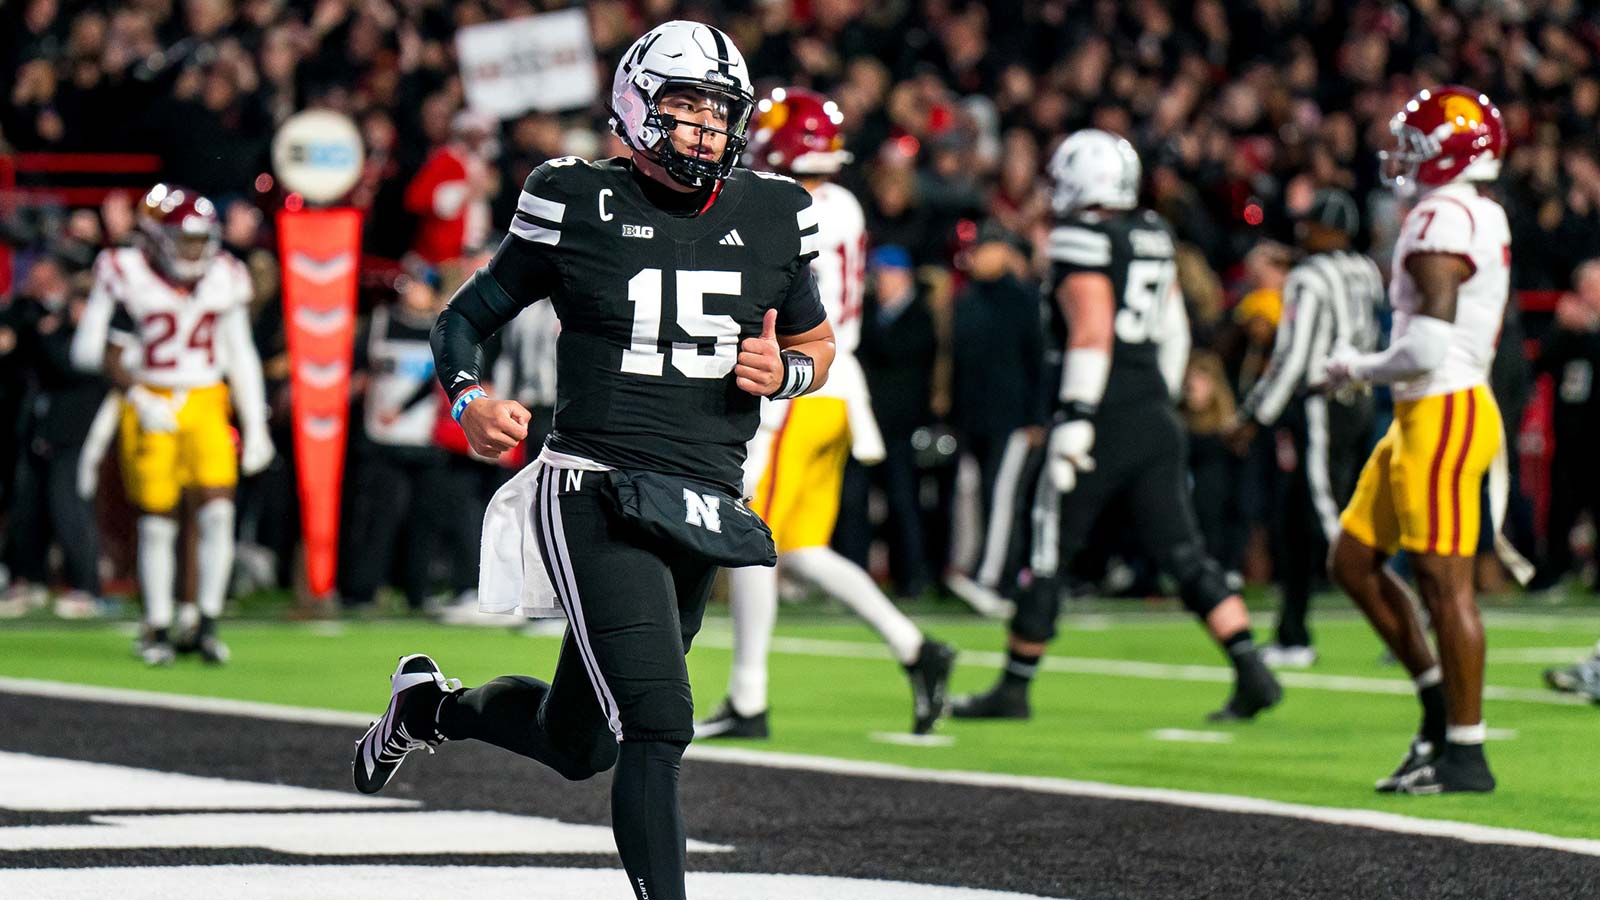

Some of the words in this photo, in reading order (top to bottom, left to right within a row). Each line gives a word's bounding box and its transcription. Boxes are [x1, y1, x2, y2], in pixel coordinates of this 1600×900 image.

[599, 188, 614, 222] C
[1418, 210, 1436, 241] 7
[143, 310, 219, 371] 24
[620, 268, 742, 379] 15
[565, 470, 584, 492] N
[682, 487, 723, 534] N
